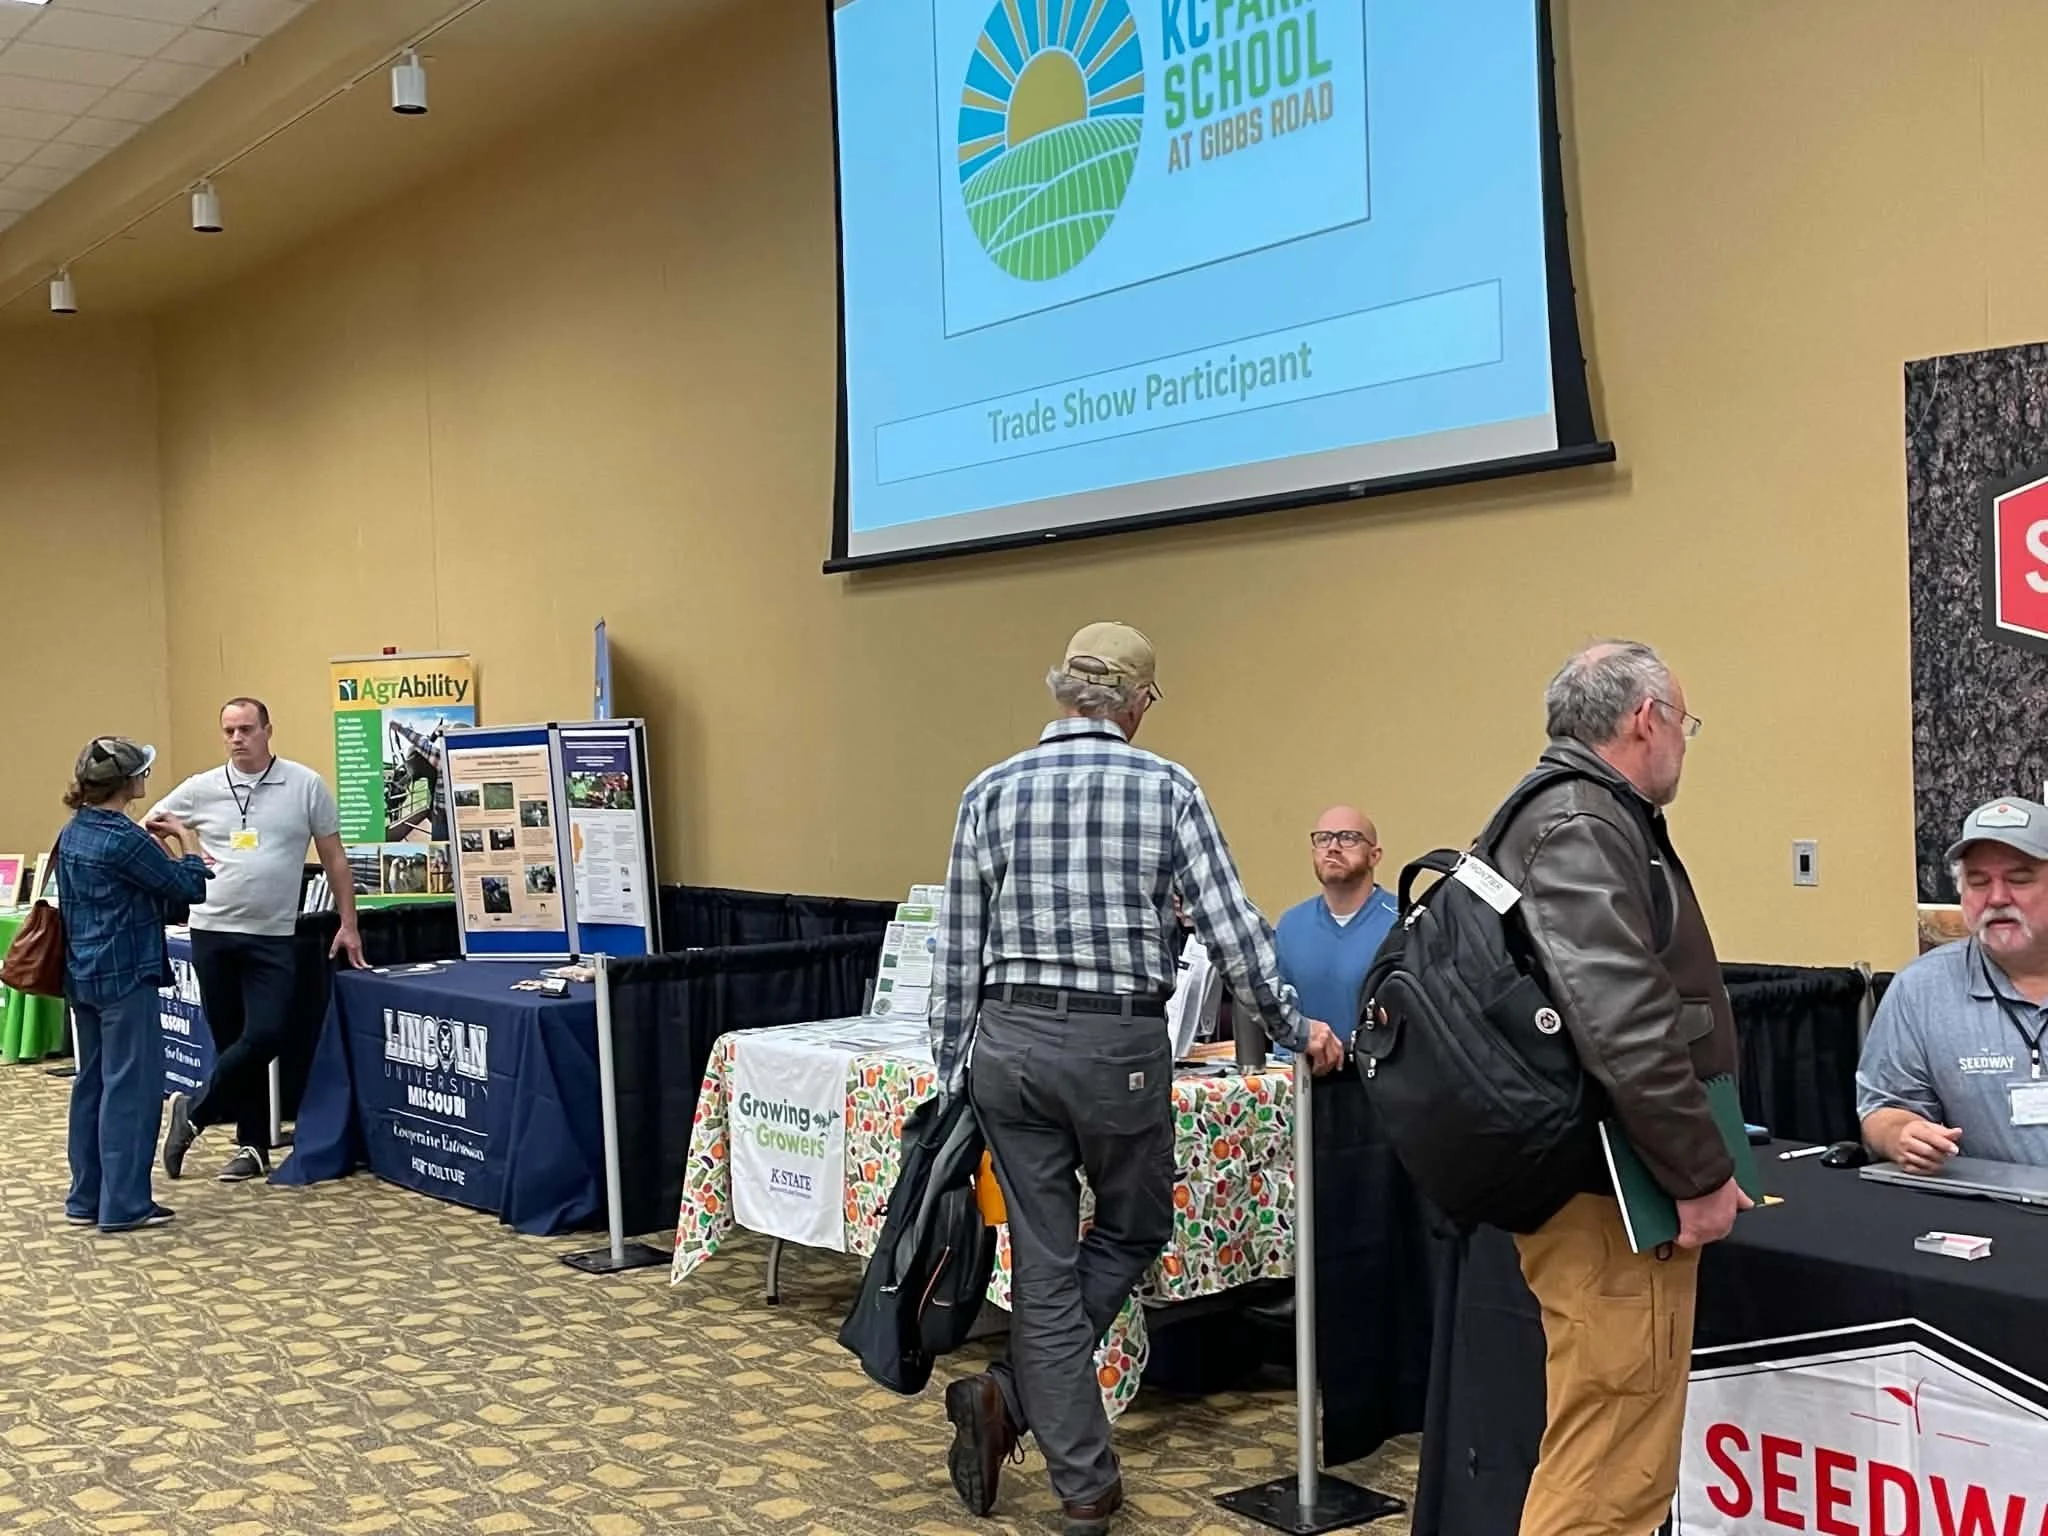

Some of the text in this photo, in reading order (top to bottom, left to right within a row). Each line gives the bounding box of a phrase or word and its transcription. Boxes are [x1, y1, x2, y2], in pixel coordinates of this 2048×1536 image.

[1164, 9, 1332, 129] SCHOOL
[1168, 80, 1333, 175] AT GIBBS ROAD
[987, 341, 1312, 444] Trade Show Participant
[361, 673, 469, 705] AgrAbility
[1959, 1056, 2016, 1070] SEEDWAY
[407, 1085, 466, 1118] MISSOURI
[739, 1092, 811, 1132] Growing
[756, 1123, 825, 1160] Growers
[770, 1168, 812, 1191] K-STATE
[1706, 1422, 2048, 1536] SEEDW
